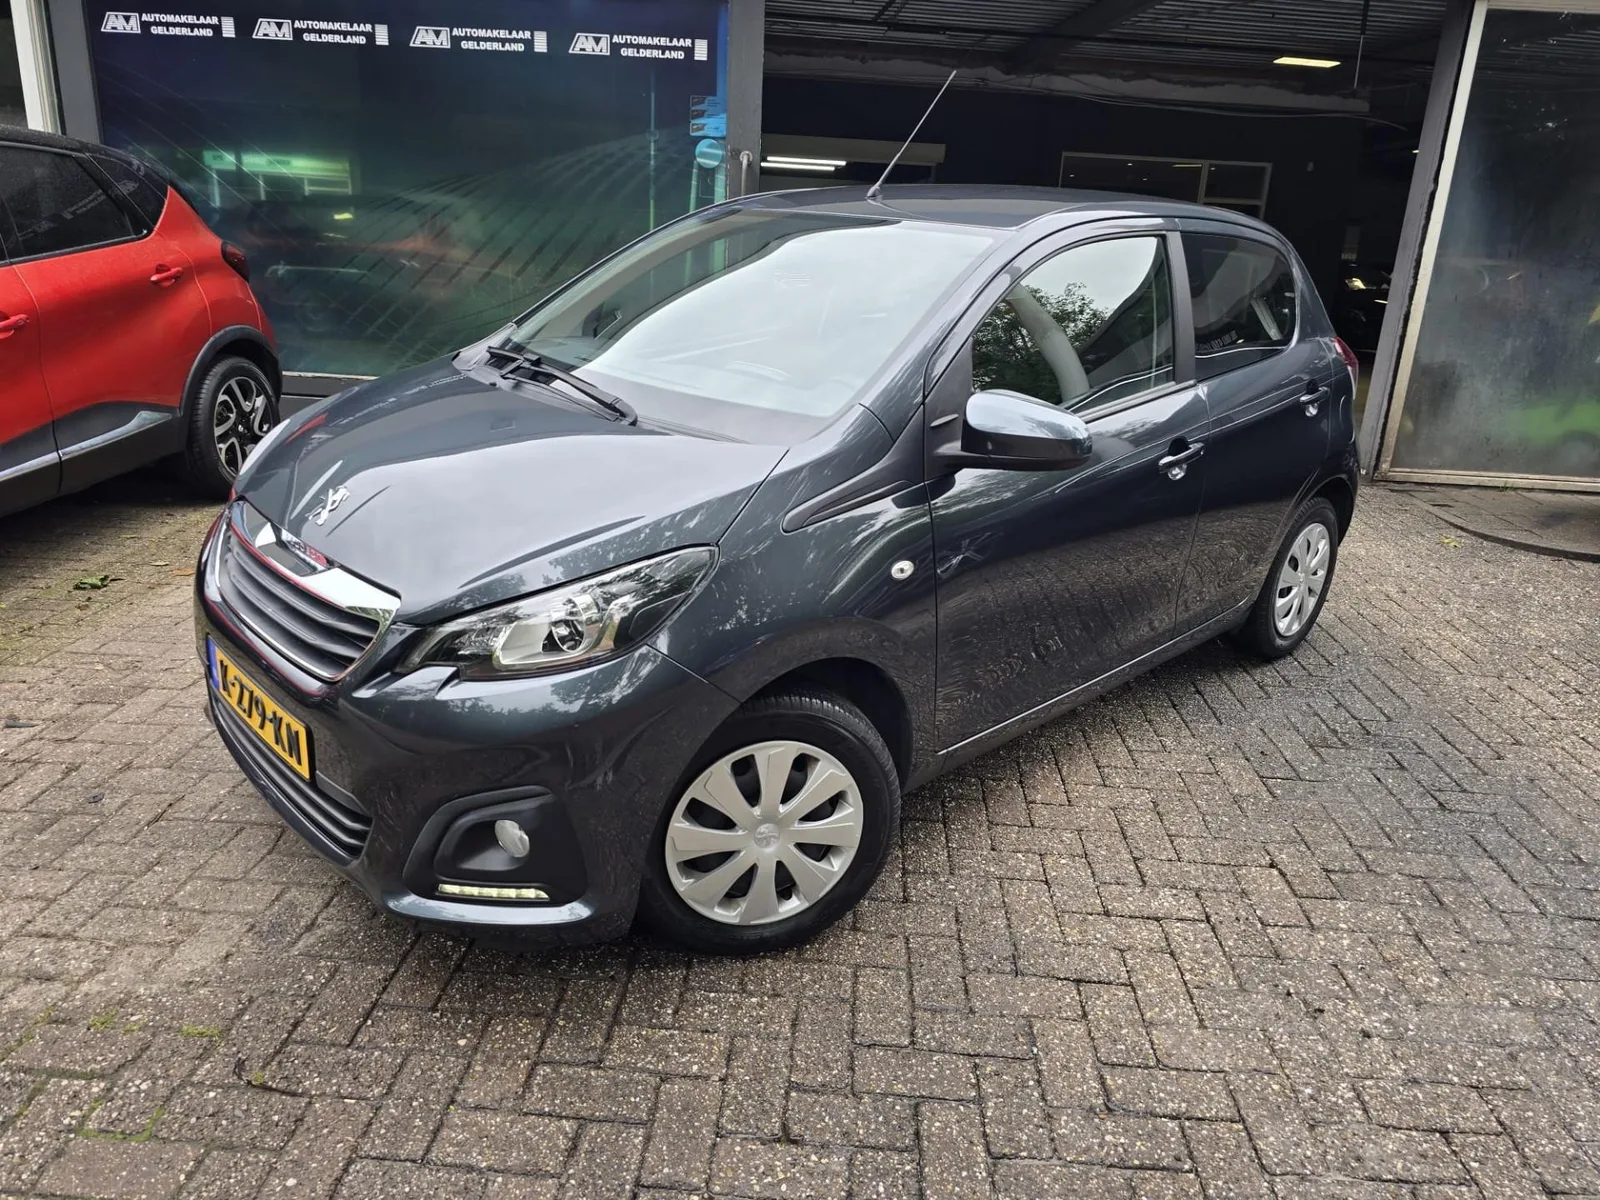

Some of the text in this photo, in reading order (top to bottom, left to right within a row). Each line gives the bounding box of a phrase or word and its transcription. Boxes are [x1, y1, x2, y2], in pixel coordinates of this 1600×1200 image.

[104, 13, 139, 32] AM
[141, 13, 220, 25] AUTOMAKELAAR
[150, 25, 213, 37] GELDERLAND
[256, 20, 291, 39] AM
[293, 20, 373, 33] AUTOMAKELAAR
[302, 32, 366, 45] GELDERLAND
[413, 28, 448, 47] AM
[452, 27, 532, 40] AUTOMAKELAAR
[460, 40, 525, 52] GELDERLAND
[572, 35, 608, 54] AM
[612, 34, 692, 48] AUTOMAKELAAR
[620, 47, 685, 60] GELDERLAND
